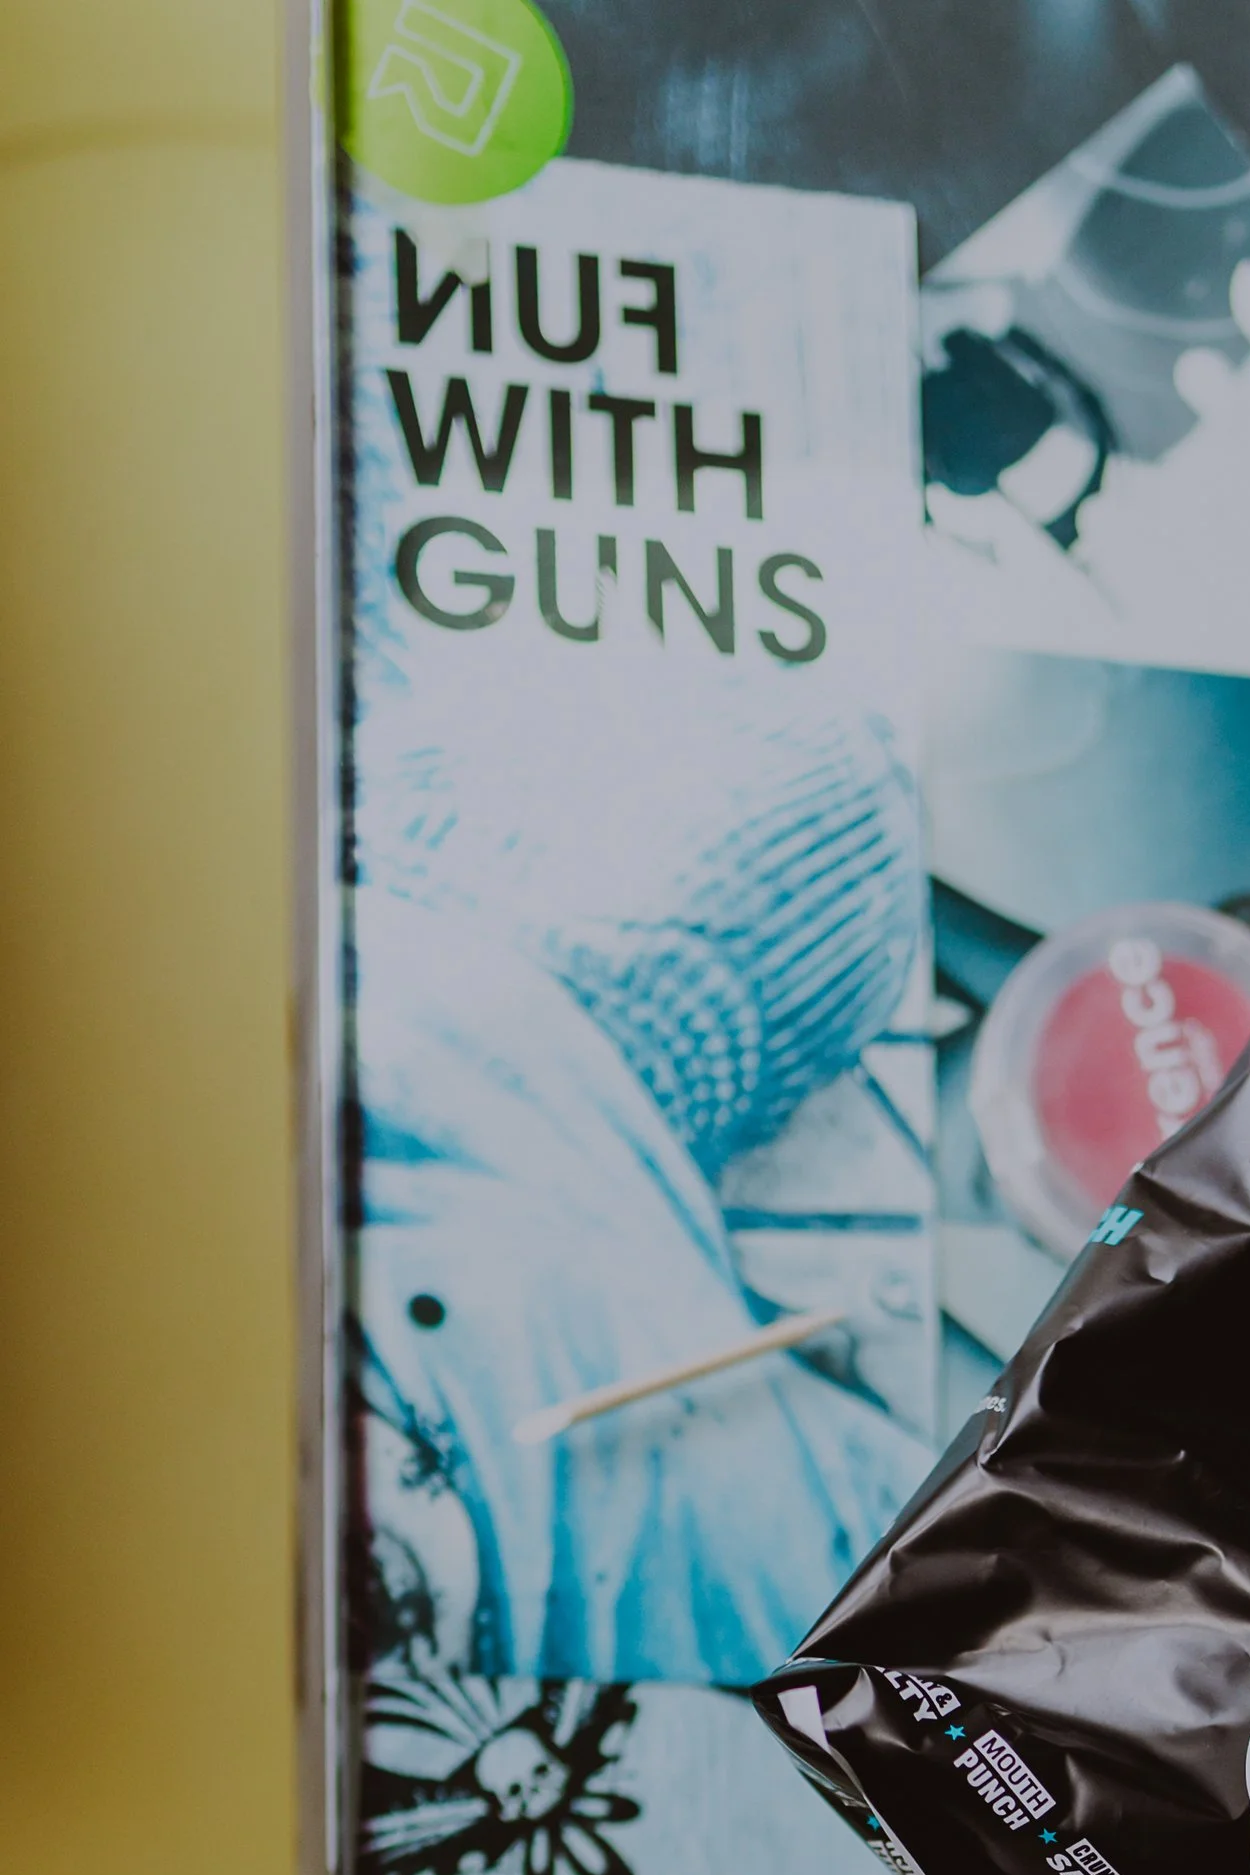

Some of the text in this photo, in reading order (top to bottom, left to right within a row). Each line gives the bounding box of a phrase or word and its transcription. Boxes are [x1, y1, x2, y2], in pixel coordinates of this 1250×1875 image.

[386, 368, 765, 521] WITH
[396, 514, 828, 665] GUNS
[952, 1747, 1031, 1831] PUNCH
[981, 1736, 1050, 1812] MOUTH
